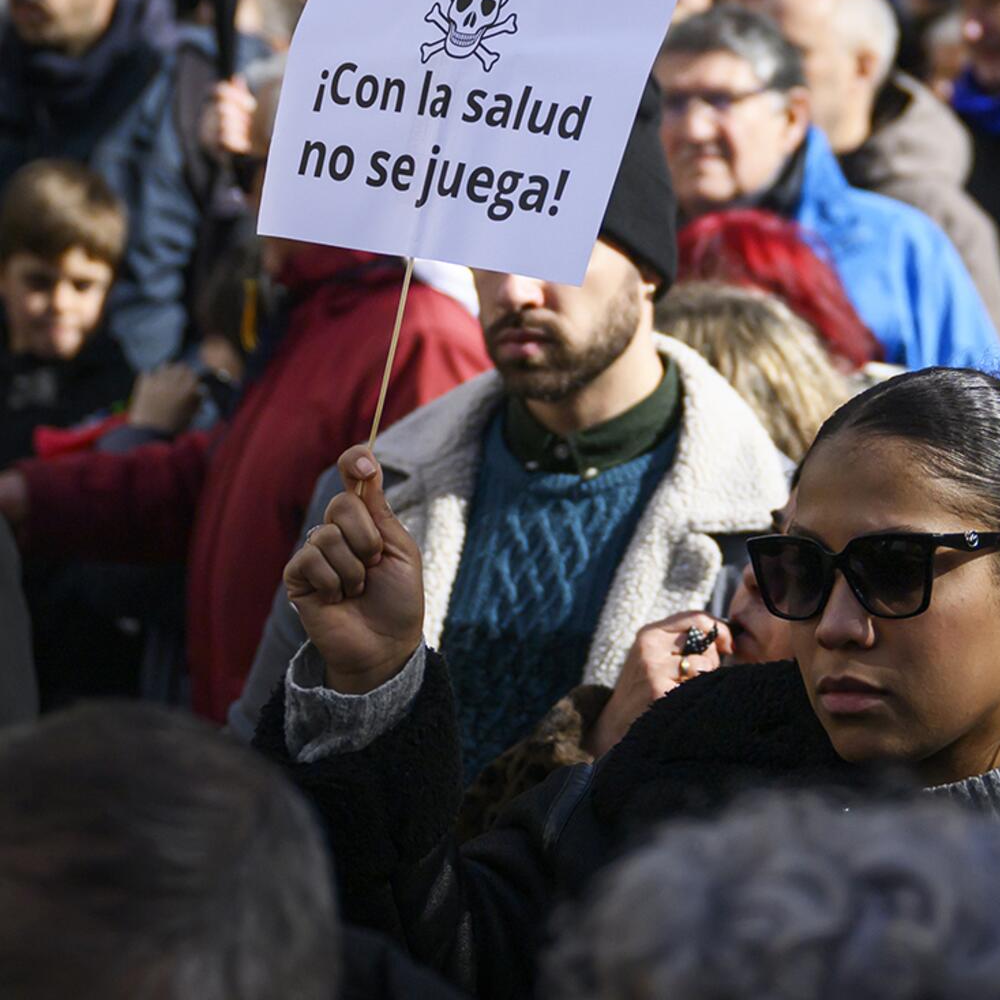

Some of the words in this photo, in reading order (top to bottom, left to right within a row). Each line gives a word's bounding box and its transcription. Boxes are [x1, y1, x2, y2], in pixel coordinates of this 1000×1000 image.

[312, 61, 406, 113] ¡Con
[417, 70, 453, 119] la
[461, 85, 593, 142] salud
[297, 139, 355, 182] no
[365, 149, 416, 192] se
[415, 144, 571, 222] juega!
